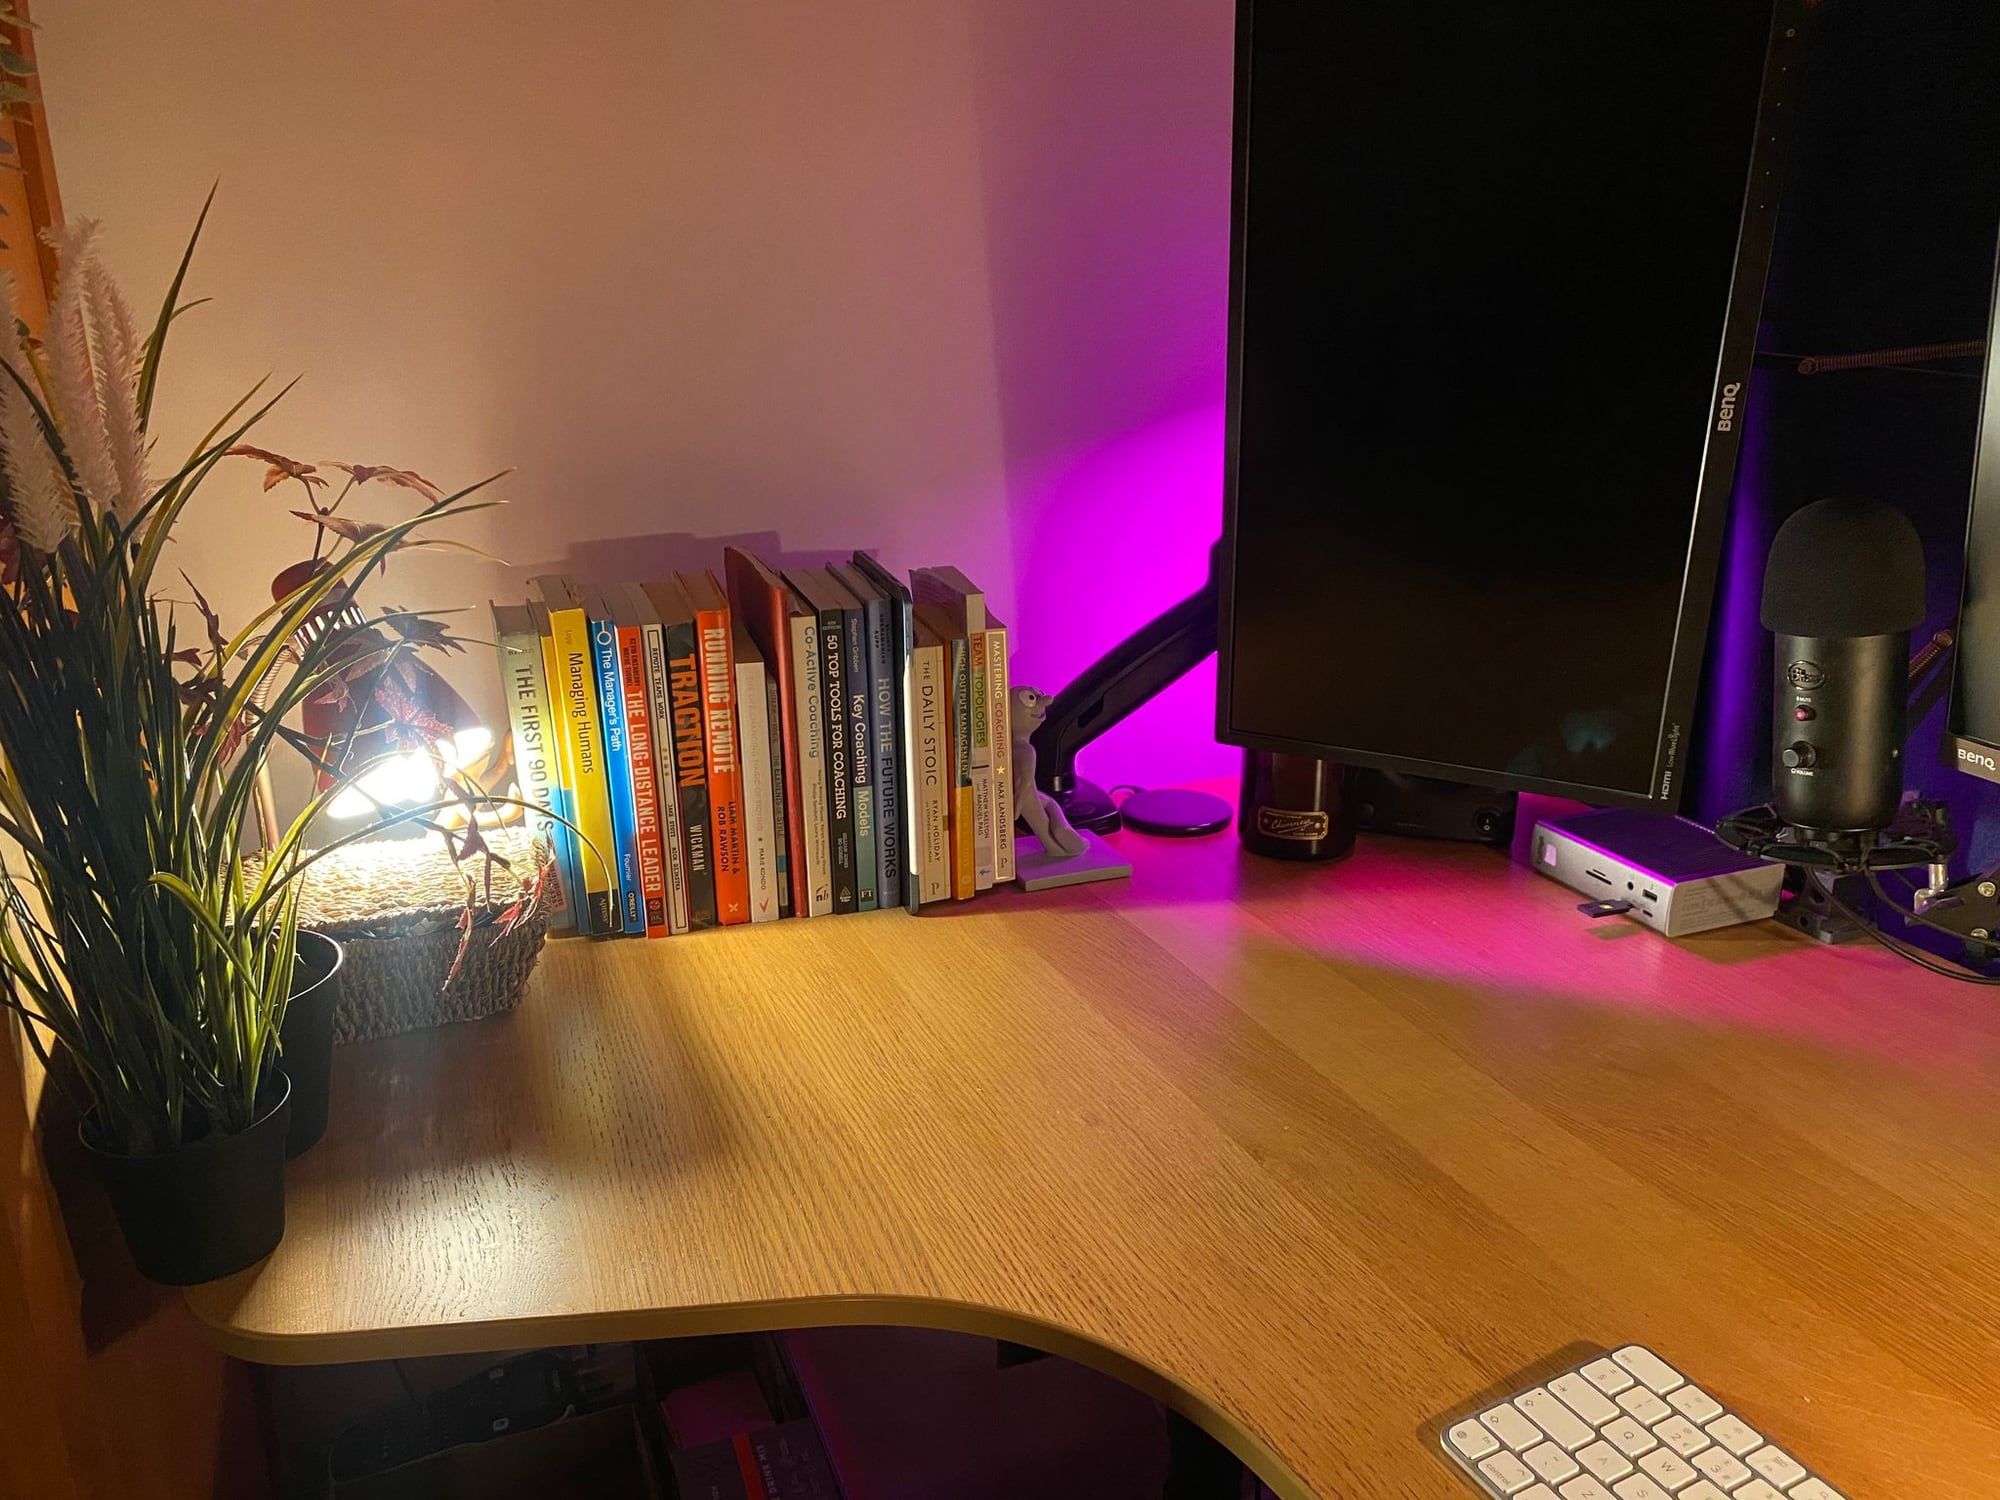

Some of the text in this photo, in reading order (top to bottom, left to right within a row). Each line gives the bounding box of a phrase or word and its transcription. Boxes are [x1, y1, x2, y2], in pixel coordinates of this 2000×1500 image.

[1717, 382, 1741, 431] BenQ
[514, 664, 535, 700] THE
[601, 648, 622, 752] The Manager's Path
[652, 648, 665, 720] REMOTE TEAMS WORK
[704, 628, 736, 775] RUNNING REMOTE
[804, 626, 820, 758] Co-Active Coaching
[878, 678, 891, 716] HOW
[959, 673, 967, 710] OUTPUT
[973, 637, 985, 744] TEAM TOPOLOGIES
[993, 641, 1004, 759] MASTERING COACHING
[520, 705, 544, 753] FIRST
[568, 652, 593, 774] Managing Humans
[669, 653, 706, 788] TRACTION
[827, 635, 847, 819] 50 TOP TOOLS FOR COACHING
[922, 686, 935, 731] DAILY
[880, 721, 893, 753] THE
[960, 713, 969, 776] MANAGEMENT
[1957, 748, 1996, 771] BenQ
[528, 759, 547, 782] 90
[851, 694, 871, 837] Key Coaching Models
[924, 738, 937, 786] STOIC
[625, 690, 661, 892] THE LONG-DISTANCE LEADER
[882, 757, 894, 818] FUTURE
[689, 824, 705, 871] WICKMAN
[718, 805, 730, 873] ROB RAWSON
[728, 800, 741, 875] LIAM MARTIN &
[883, 822, 896, 878] WORKS
[931, 800, 940, 861] RYAN HOLIDAY
[999, 802, 1007, 850] LANDSBERG
[623, 853, 632, 881] Fournier
[1623, 1431, 1635, 1440] Q
[1671, 1432, 1682, 1442] 2
[1486, 1462, 1512, 1486] control
[1660, 1460, 1676, 1473] W
[1711, 1465, 1720, 1473] 3
[1636, 1489, 1649, 1498] S
